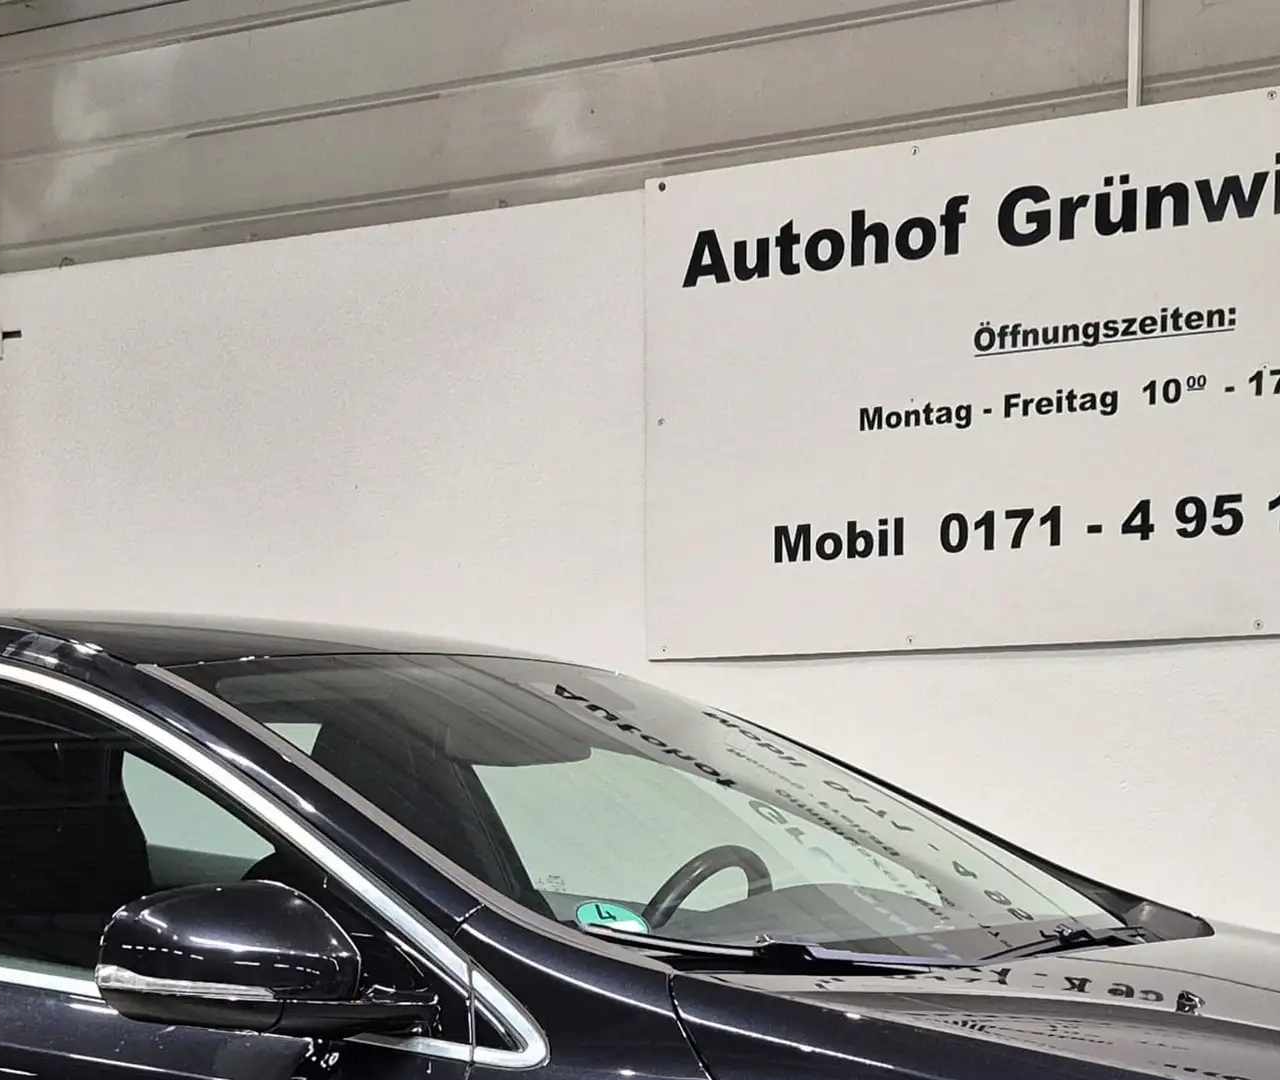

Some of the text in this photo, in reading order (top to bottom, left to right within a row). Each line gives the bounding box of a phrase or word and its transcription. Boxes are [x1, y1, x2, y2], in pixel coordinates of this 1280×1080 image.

[683, 195, 970, 288] Autohof
[973, 307, 1236, 355] Öffnungszeiten:
[859, 401, 972, 432] Montag
[1004, 387, 1118, 418] Freitag
[774, 517, 904, 563] Mobil
[940, 505, 1061, 553] 0171
[1121, 498, 1155, 541] 4
[1174, 493, 1244, 539] 95
